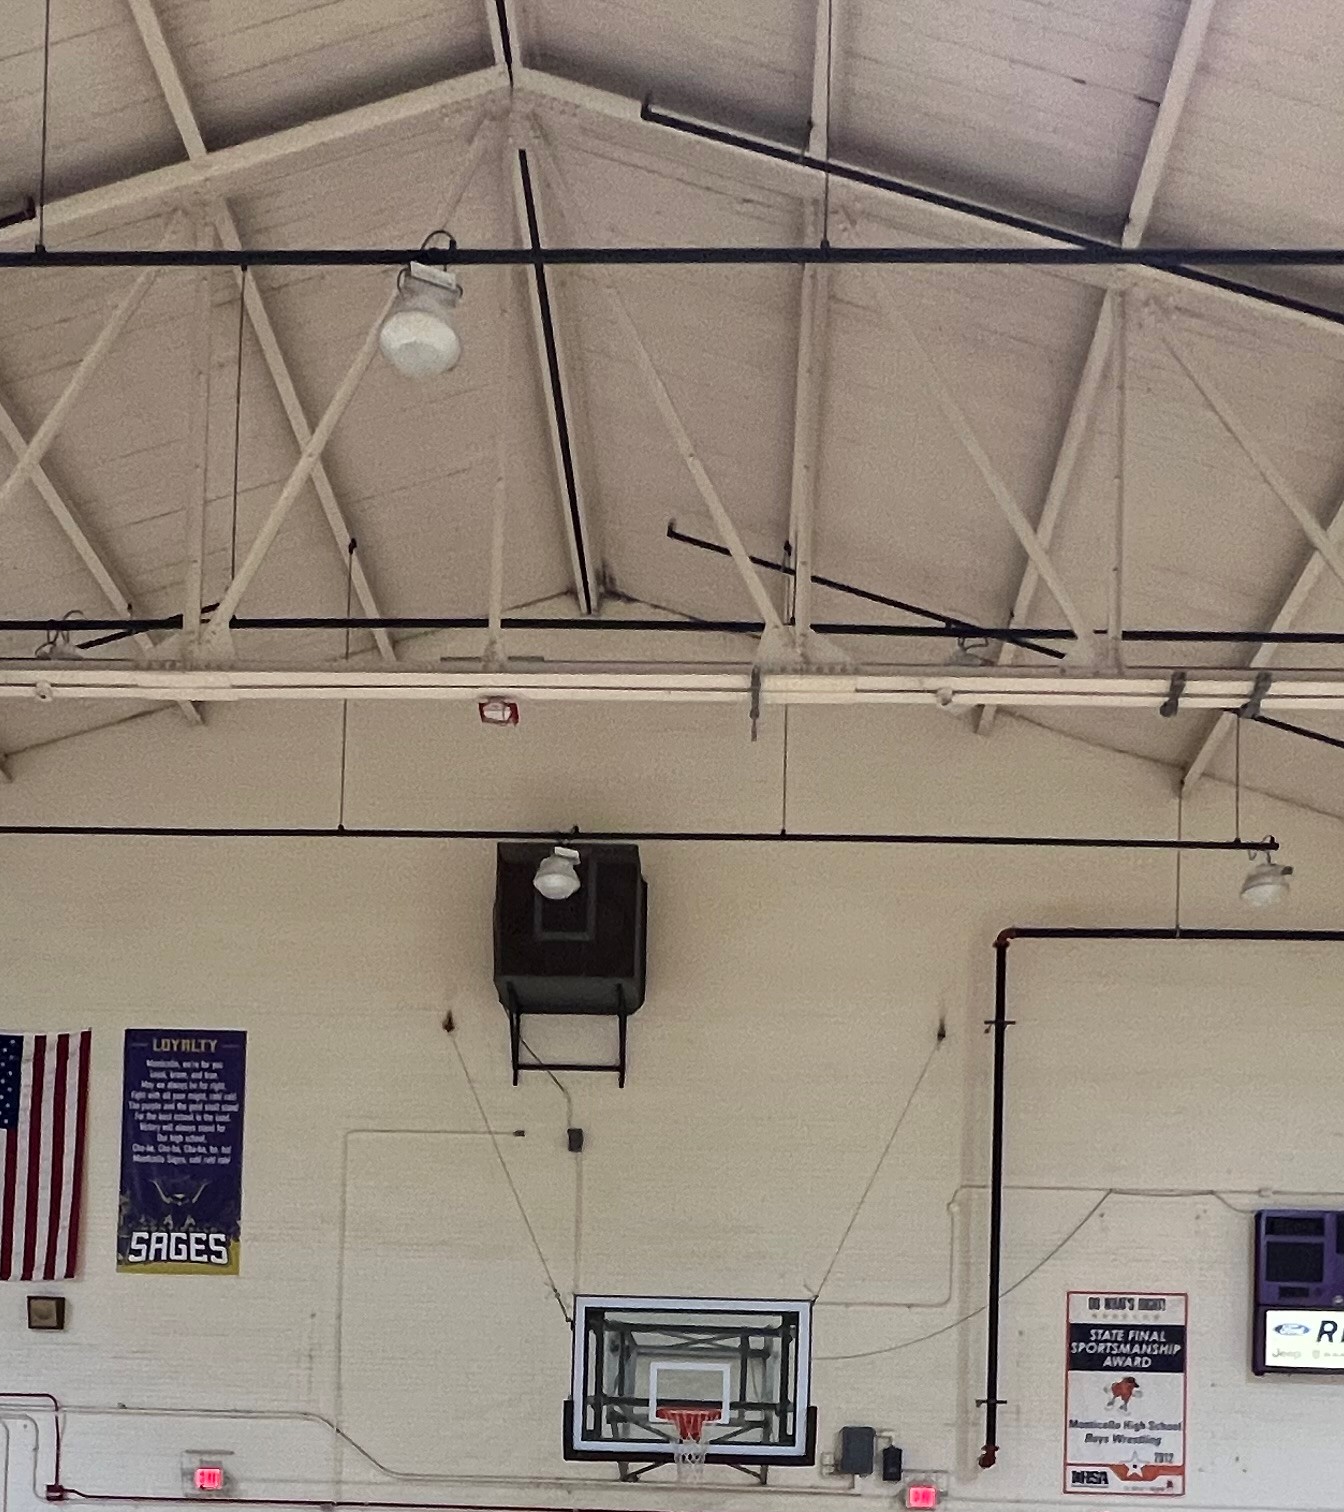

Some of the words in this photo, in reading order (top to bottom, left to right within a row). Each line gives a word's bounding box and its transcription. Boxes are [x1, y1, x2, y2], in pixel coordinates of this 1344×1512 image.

[152, 1038, 217, 1053] LOYALTY
[128, 1231, 228, 1264] SAGES
[1089, 1328, 1125, 1342] STATE
[1127, 1329, 1167, 1343] FINAL
[1070, 1341, 1182, 1356] SPORTSMANSHIP
[1102, 1355, 1153, 1369] AWARD
